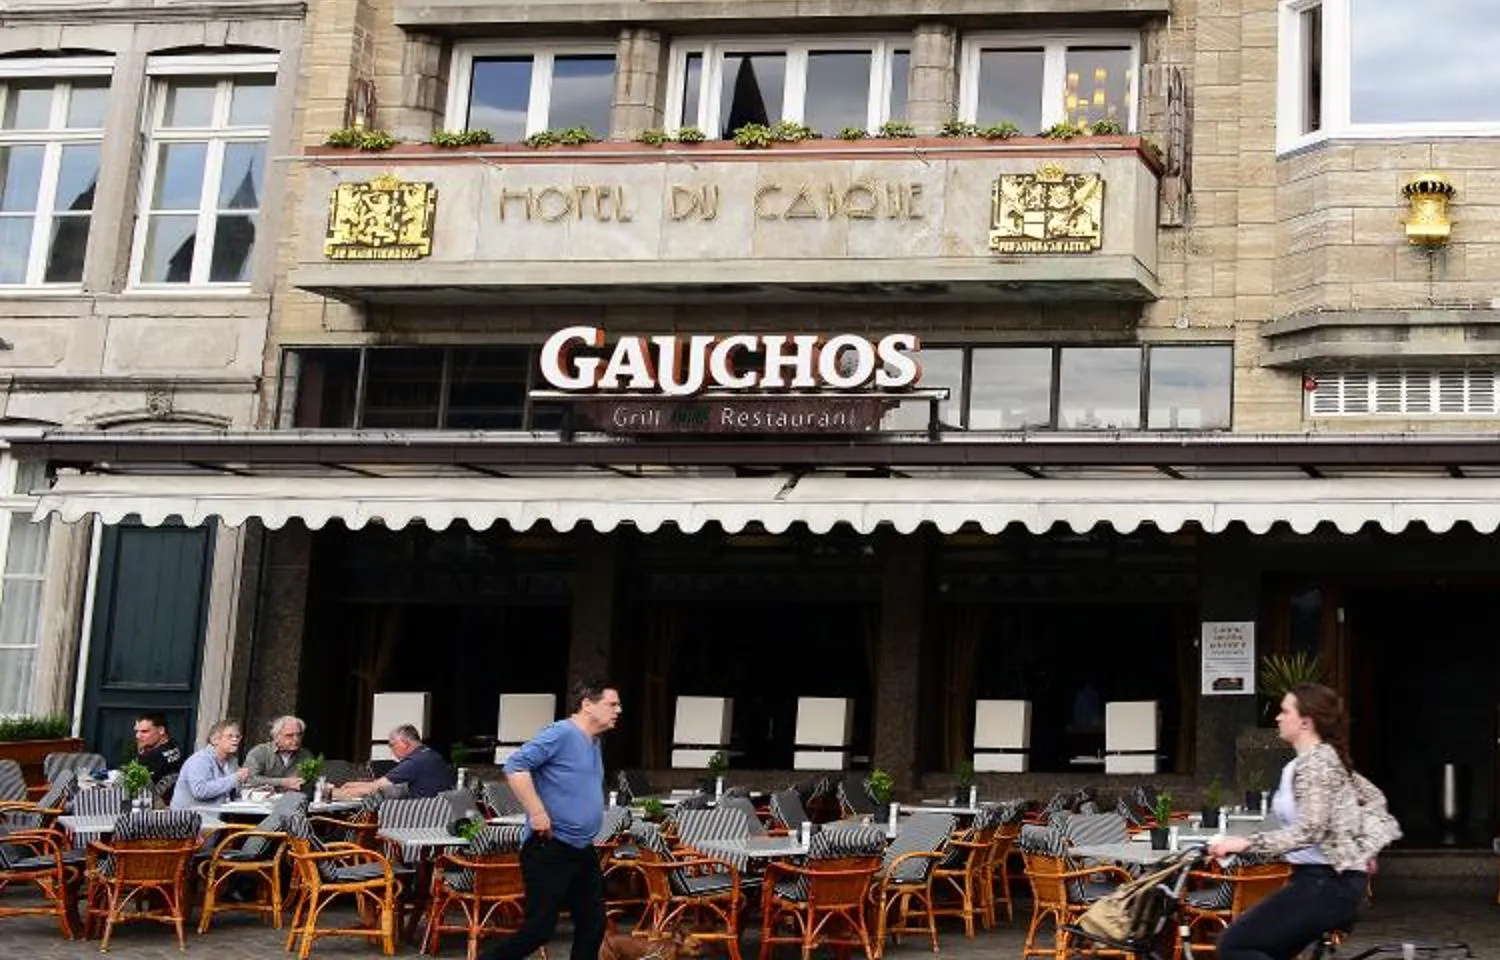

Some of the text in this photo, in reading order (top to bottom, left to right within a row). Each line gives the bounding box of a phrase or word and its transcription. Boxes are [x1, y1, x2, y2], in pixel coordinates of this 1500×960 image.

[499, 185, 632, 223] HOTEL
[669, 184, 719, 222] DU
[540, 325, 921, 396] GAUCHOS
[613, 407, 856, 427] Grill Restaurant
